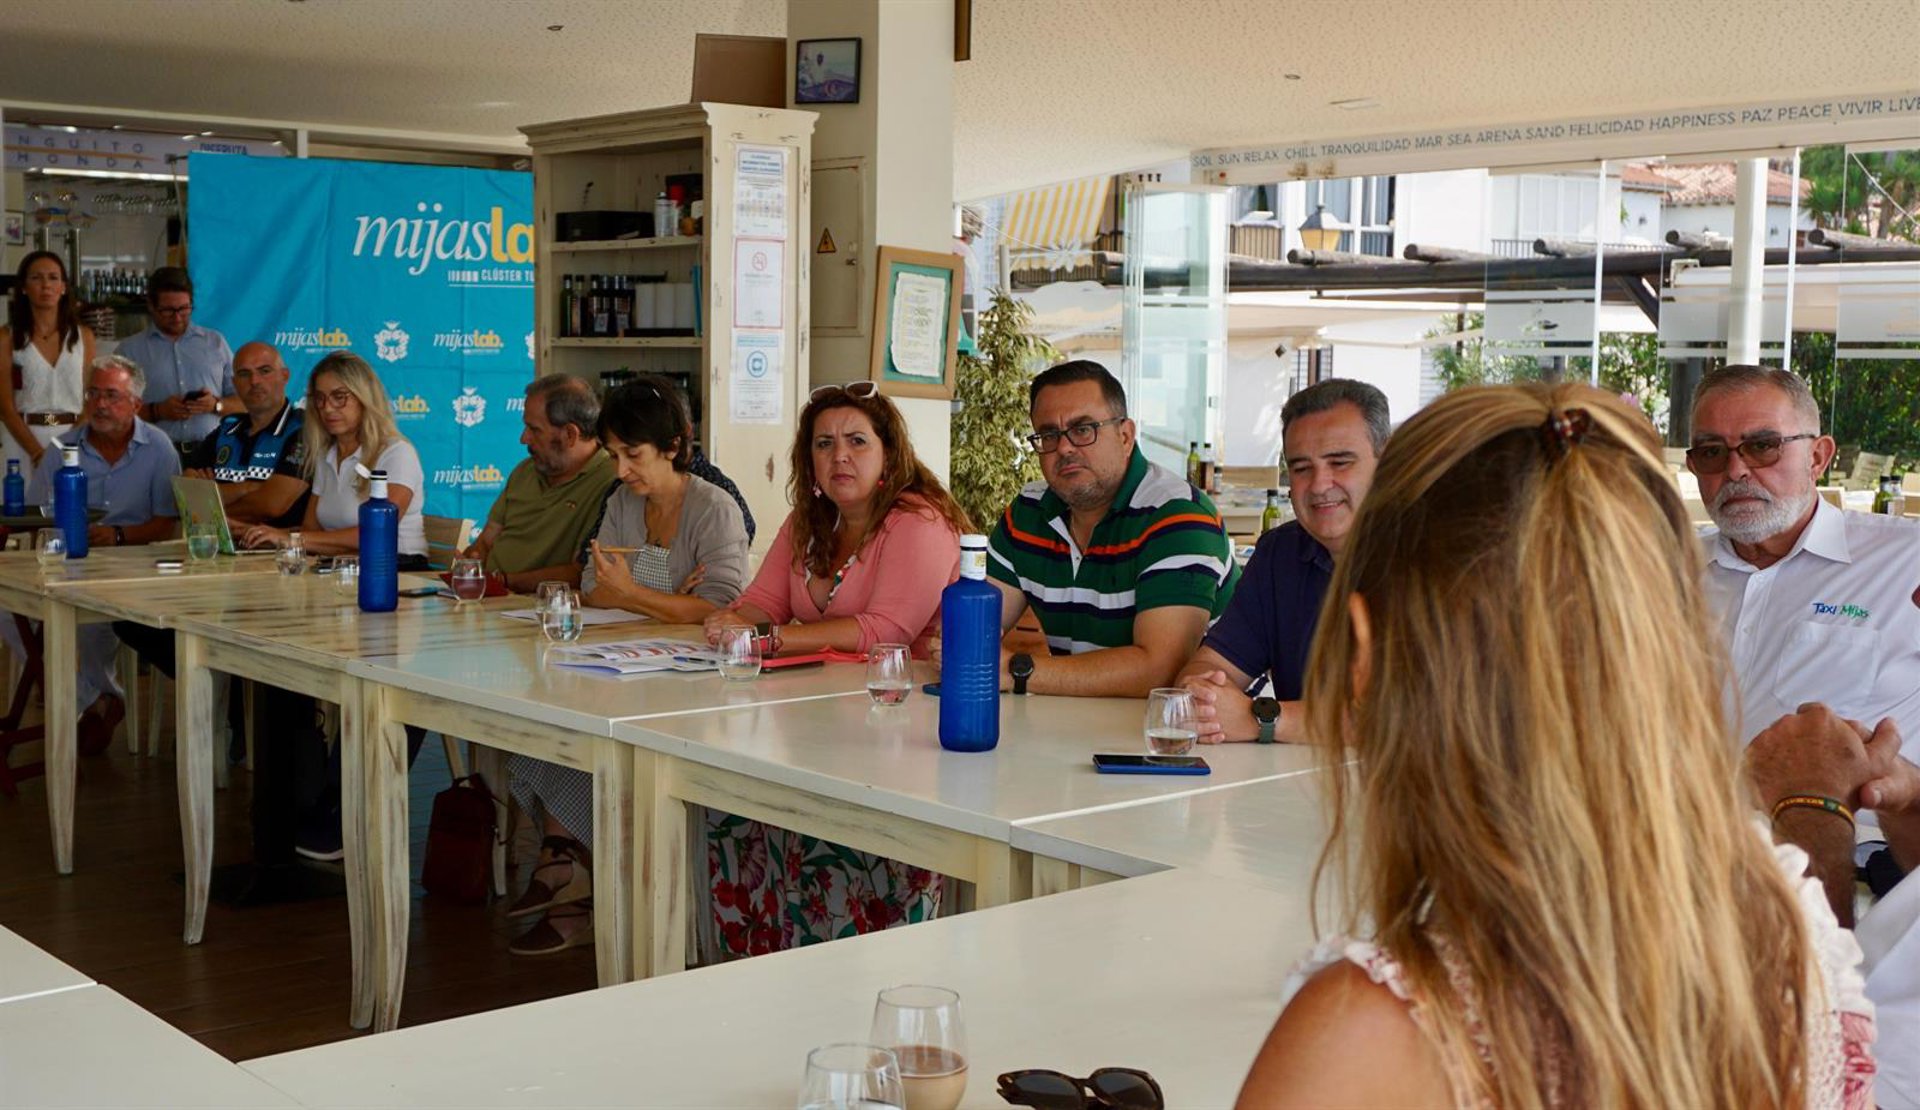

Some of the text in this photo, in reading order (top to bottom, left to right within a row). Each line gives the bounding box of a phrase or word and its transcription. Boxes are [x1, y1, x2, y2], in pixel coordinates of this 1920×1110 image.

[1193, 155, 1212, 167] SOL
[1218, 153, 1240, 165] SUN
[1244, 150, 1279, 162] RELAX
[1284, 147, 1317, 161] CHILL
[1321, 138, 1412, 156] TRANQUILIDAD
[1415, 135, 1443, 149] MAR
[1447, 132, 1473, 147] SEA
[1476, 128, 1522, 143] ARENA
[1525, 125, 1566, 140] SAND
[1569, 119, 1645, 137] FELICIDAD
[1649, 111, 1736, 131] HAPPINESS
[1741, 107, 1773, 123] PAZ
[1777, 103, 1833, 121] PEACE
[1837, 99, 1884, 116] VIVIR
[1812, 602, 1869, 619] Taxi Mijas
